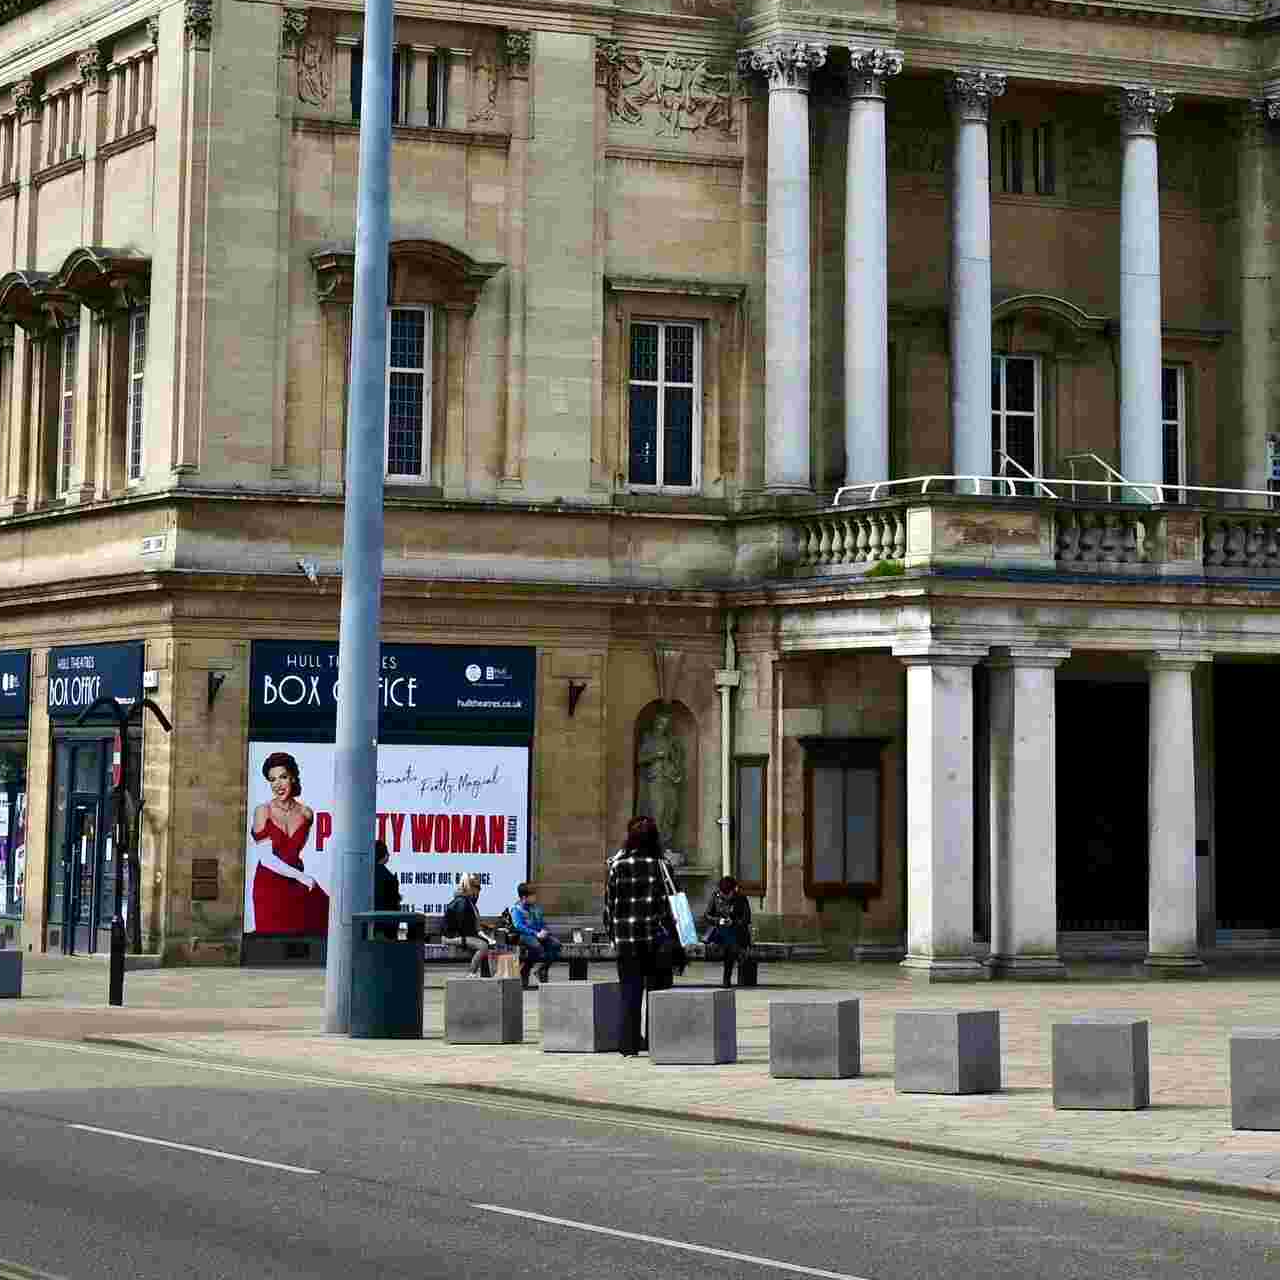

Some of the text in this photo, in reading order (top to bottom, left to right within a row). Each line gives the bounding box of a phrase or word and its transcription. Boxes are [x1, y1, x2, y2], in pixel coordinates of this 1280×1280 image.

[288, 655, 320, 668] HULL
[49, 676, 100, 706] BOX OFFICE
[264, 674, 320, 705] BOX
[411, 813, 505, 854] WOMAN
[415, 872, 436, 885] NIGHT
